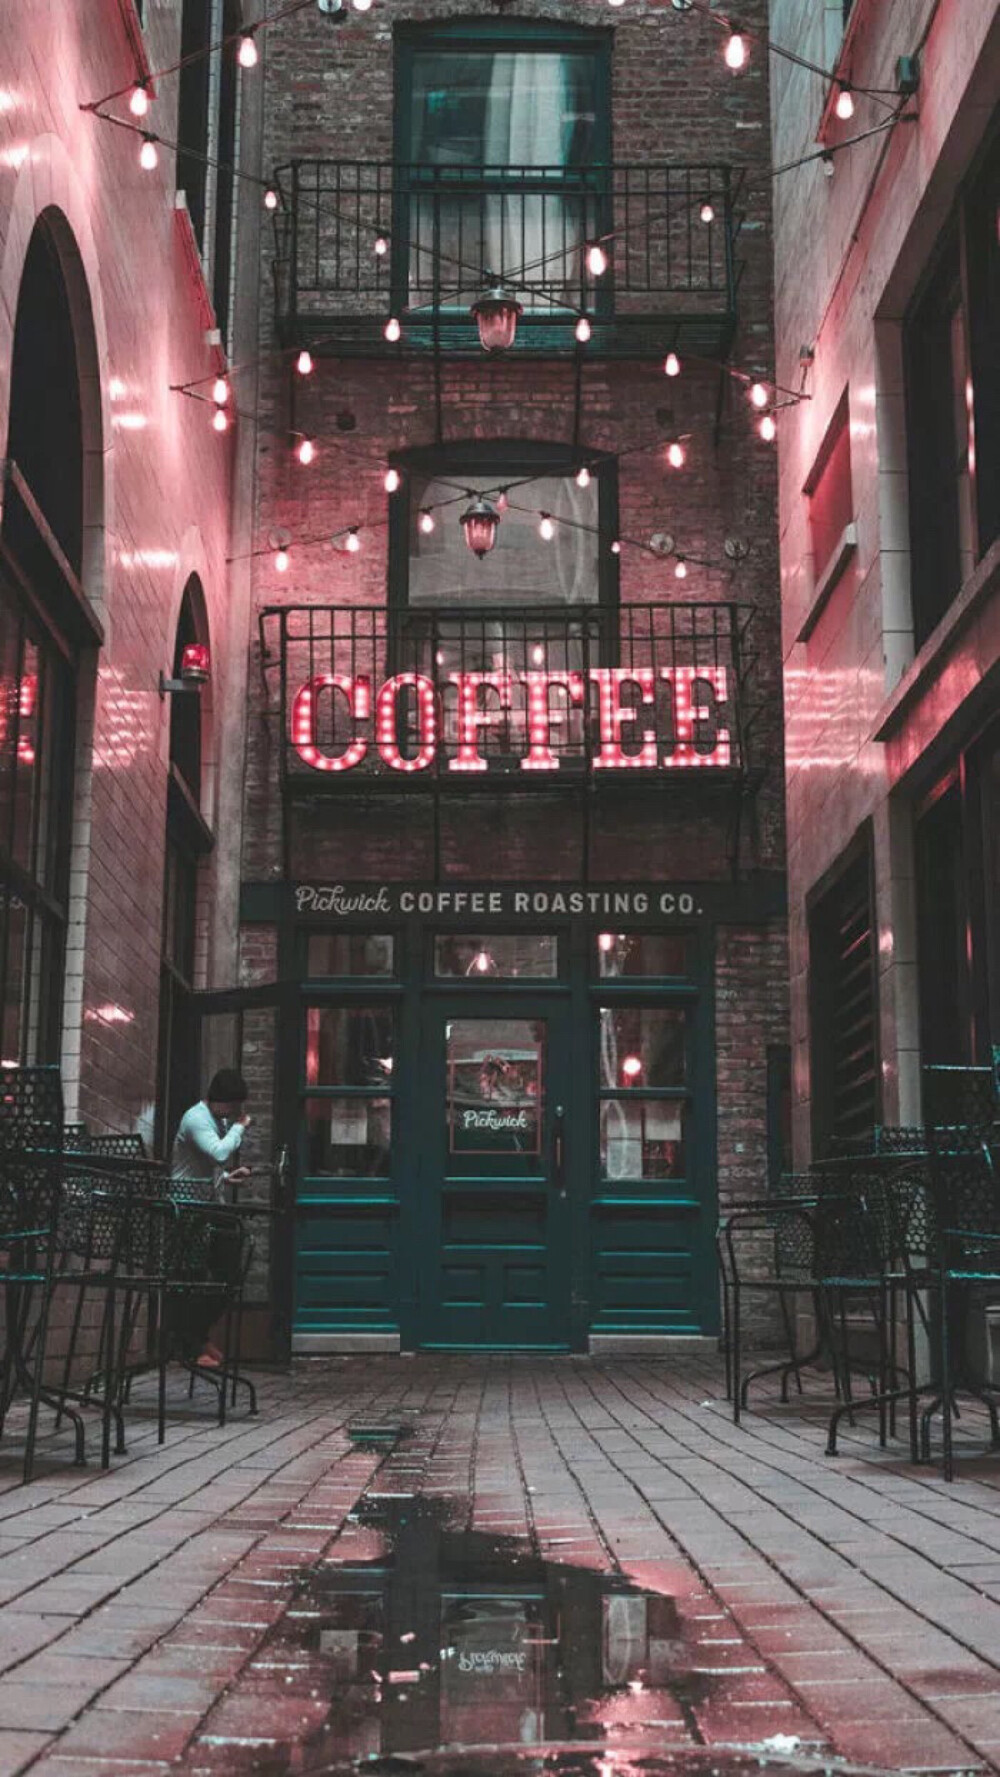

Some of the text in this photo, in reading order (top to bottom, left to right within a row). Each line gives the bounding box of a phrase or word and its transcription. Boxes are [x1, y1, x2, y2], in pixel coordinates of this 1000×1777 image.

[291, 667, 731, 771] COFFEE
[294, 885, 703, 915] Pickwick COFFEE ROASTING CO.
[463, 1109, 527, 1130] Pickwick
